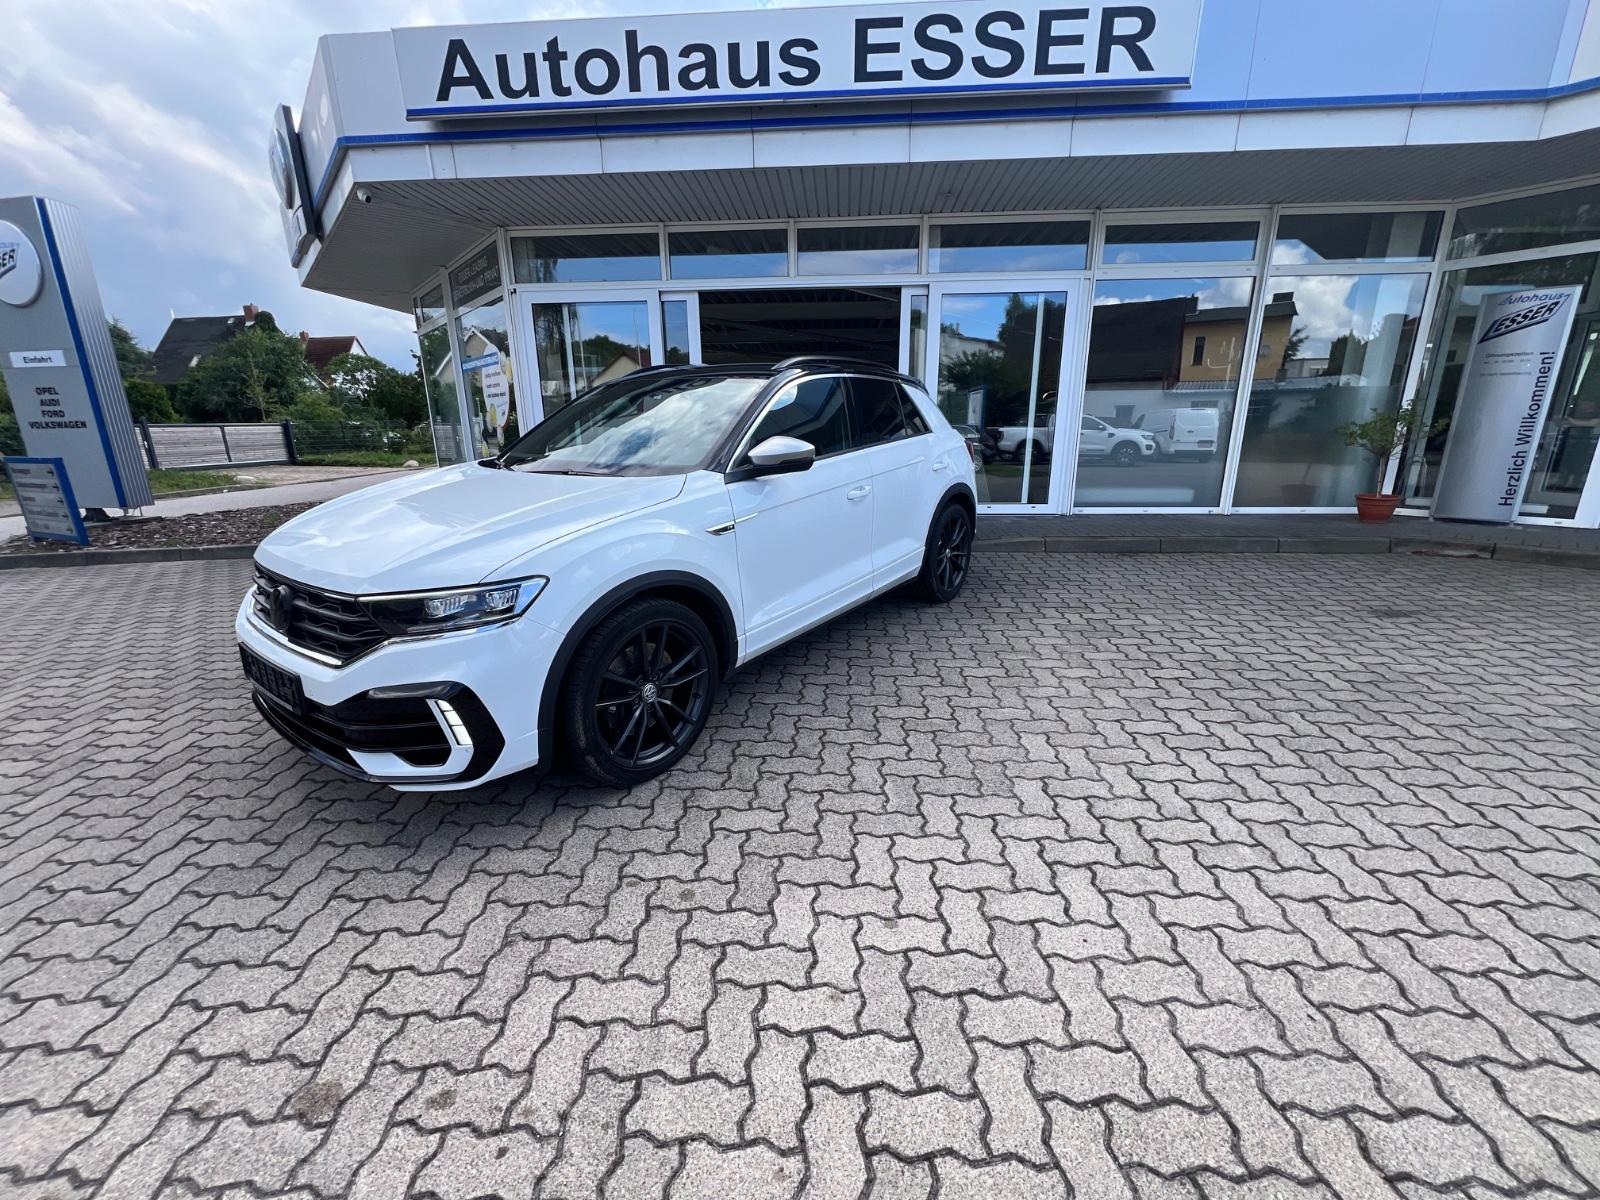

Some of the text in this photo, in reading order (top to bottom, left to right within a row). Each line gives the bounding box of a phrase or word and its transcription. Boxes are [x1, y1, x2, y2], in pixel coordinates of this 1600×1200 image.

[436, 6, 1156, 102] Autohaus ESSER
[1498, 292, 1564, 306] Autohaus
[1494, 301, 1560, 333] ESSER
[22, 355, 54, 364] Einfahrt
[35, 387, 59, 395] OPEL
[40, 398, 61, 407] AUDI
[41, 410, 65, 418] FORD
[28, 420, 87, 430] VOLKSWAGEN
[1498, 352, 1555, 506] Herzlich Willkommen!
